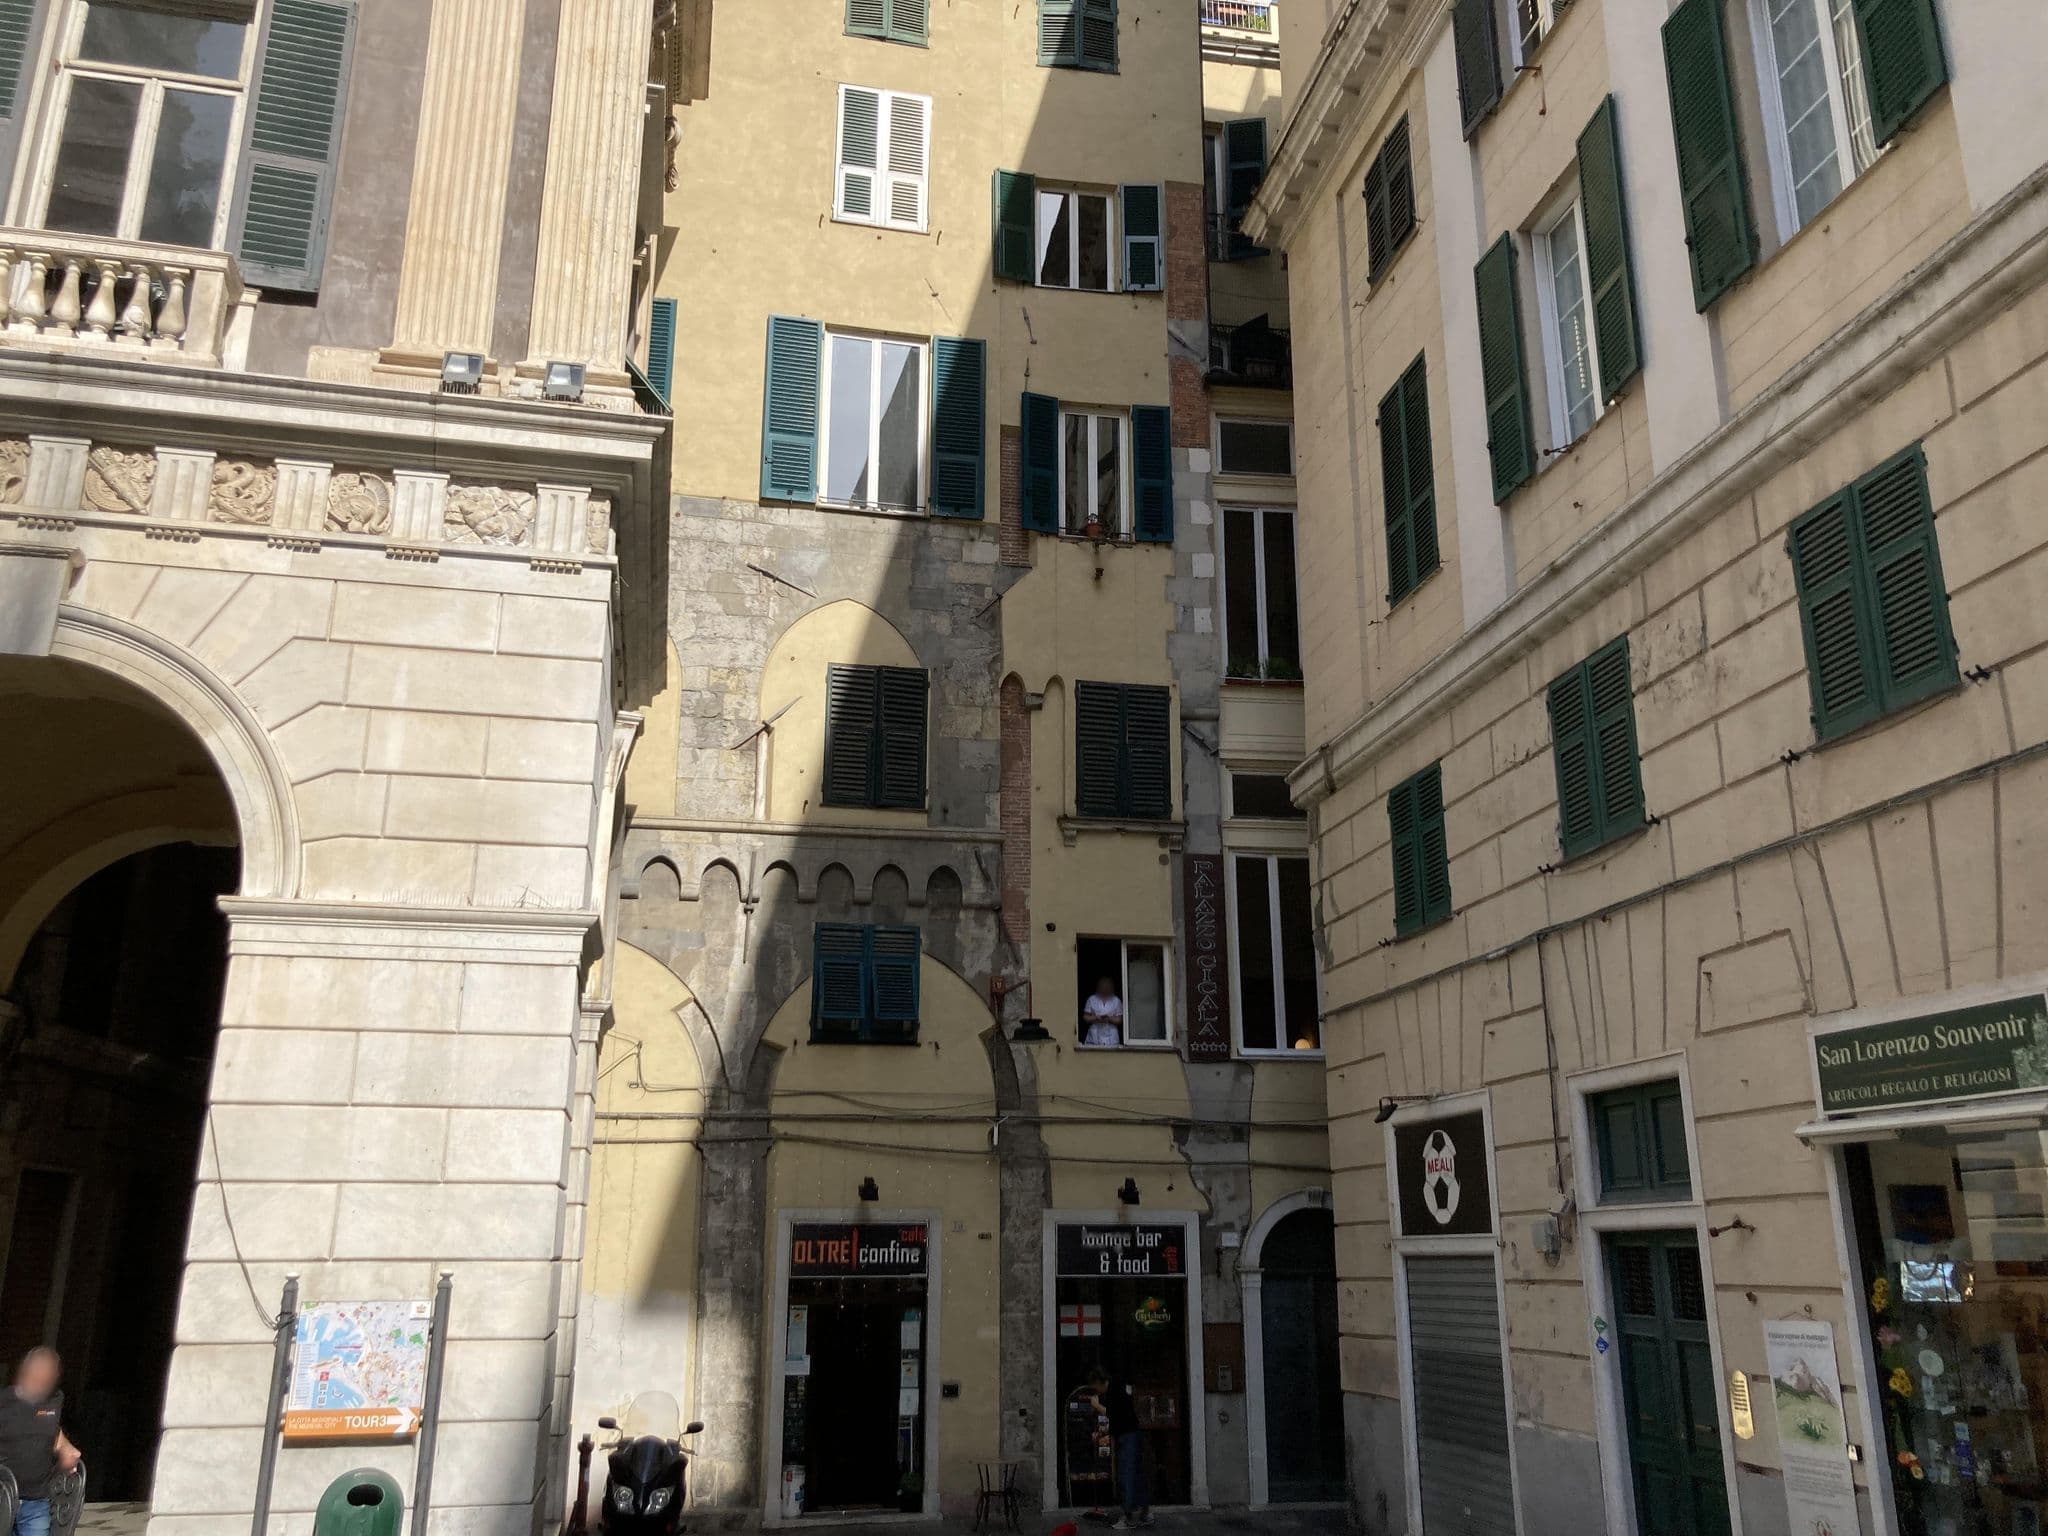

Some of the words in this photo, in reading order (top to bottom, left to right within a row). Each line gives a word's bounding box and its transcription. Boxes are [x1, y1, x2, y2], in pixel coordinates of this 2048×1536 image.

[1193, 860, 1216, 949] PALAZZO
[1197, 955, 1219, 1036] CICALA
[1819, 1045, 1851, 1068] San
[1854, 1033, 1930, 1062] Lorenzo
[1934, 1014, 2028, 1049] Souvenir
[1827, 1084, 1879, 1103] ARTICOLI
[1881, 1077, 1929, 1098] REGALO
[1932, 1077, 1940, 1090] E
[1945, 1067, 2012, 1089] RELIGIOSI
[1427, 1157, 1452, 1174] MEALI
[1136, 1225, 1162, 1247] bar
[859, 1240, 921, 1264] confine
[1099, 1252, 1110, 1273] &
[1117, 1252, 1150, 1273] food
[344, 1415, 387, 1428] TOUR3
